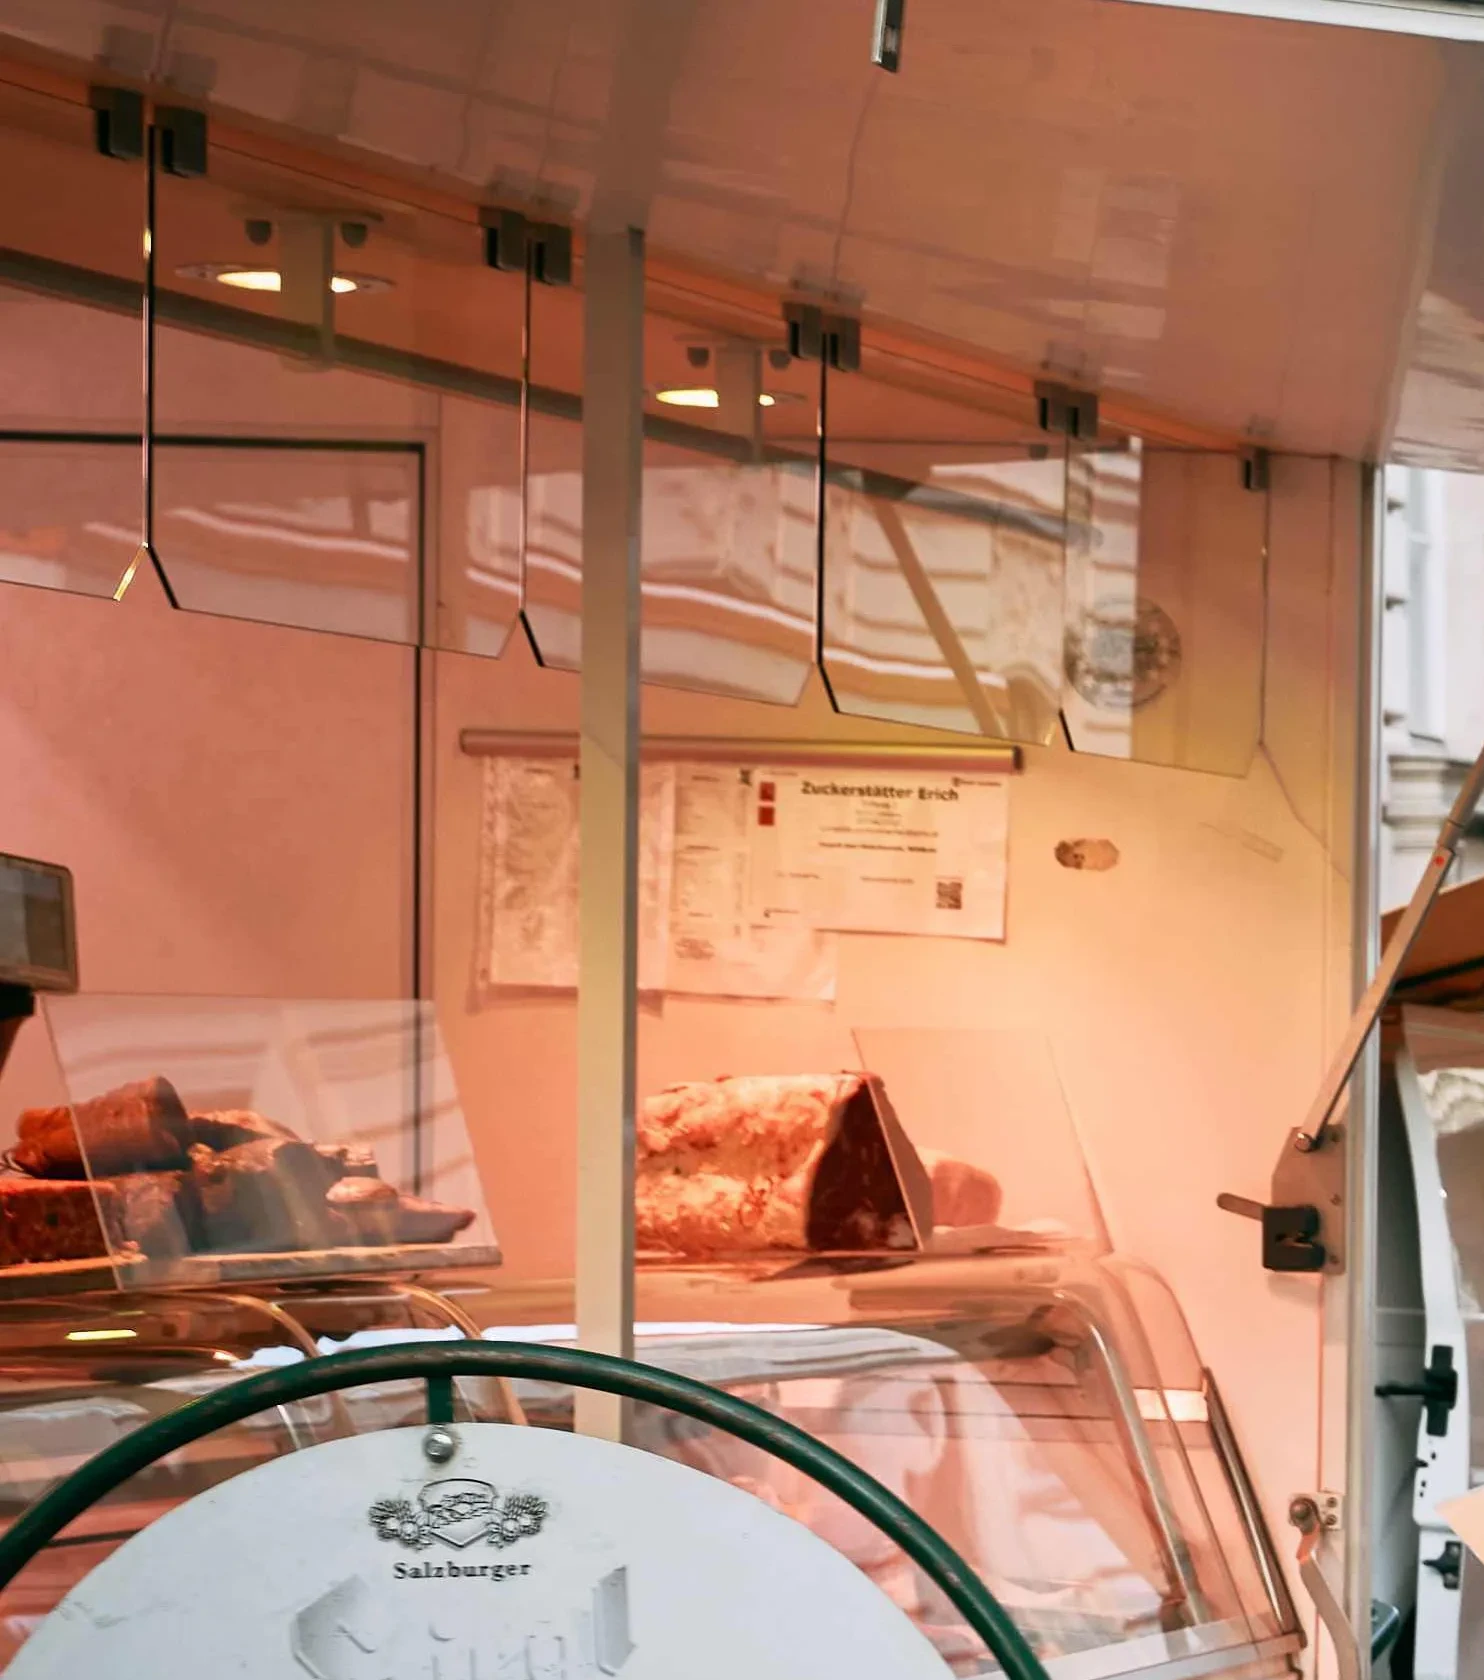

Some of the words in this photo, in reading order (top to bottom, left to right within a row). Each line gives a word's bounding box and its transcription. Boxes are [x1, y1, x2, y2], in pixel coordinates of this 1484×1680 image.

[801, 781, 913, 799] Zuckerstätter
[917, 786, 959, 801] Erich
[393, 1562, 532, 1582] Salzburger
